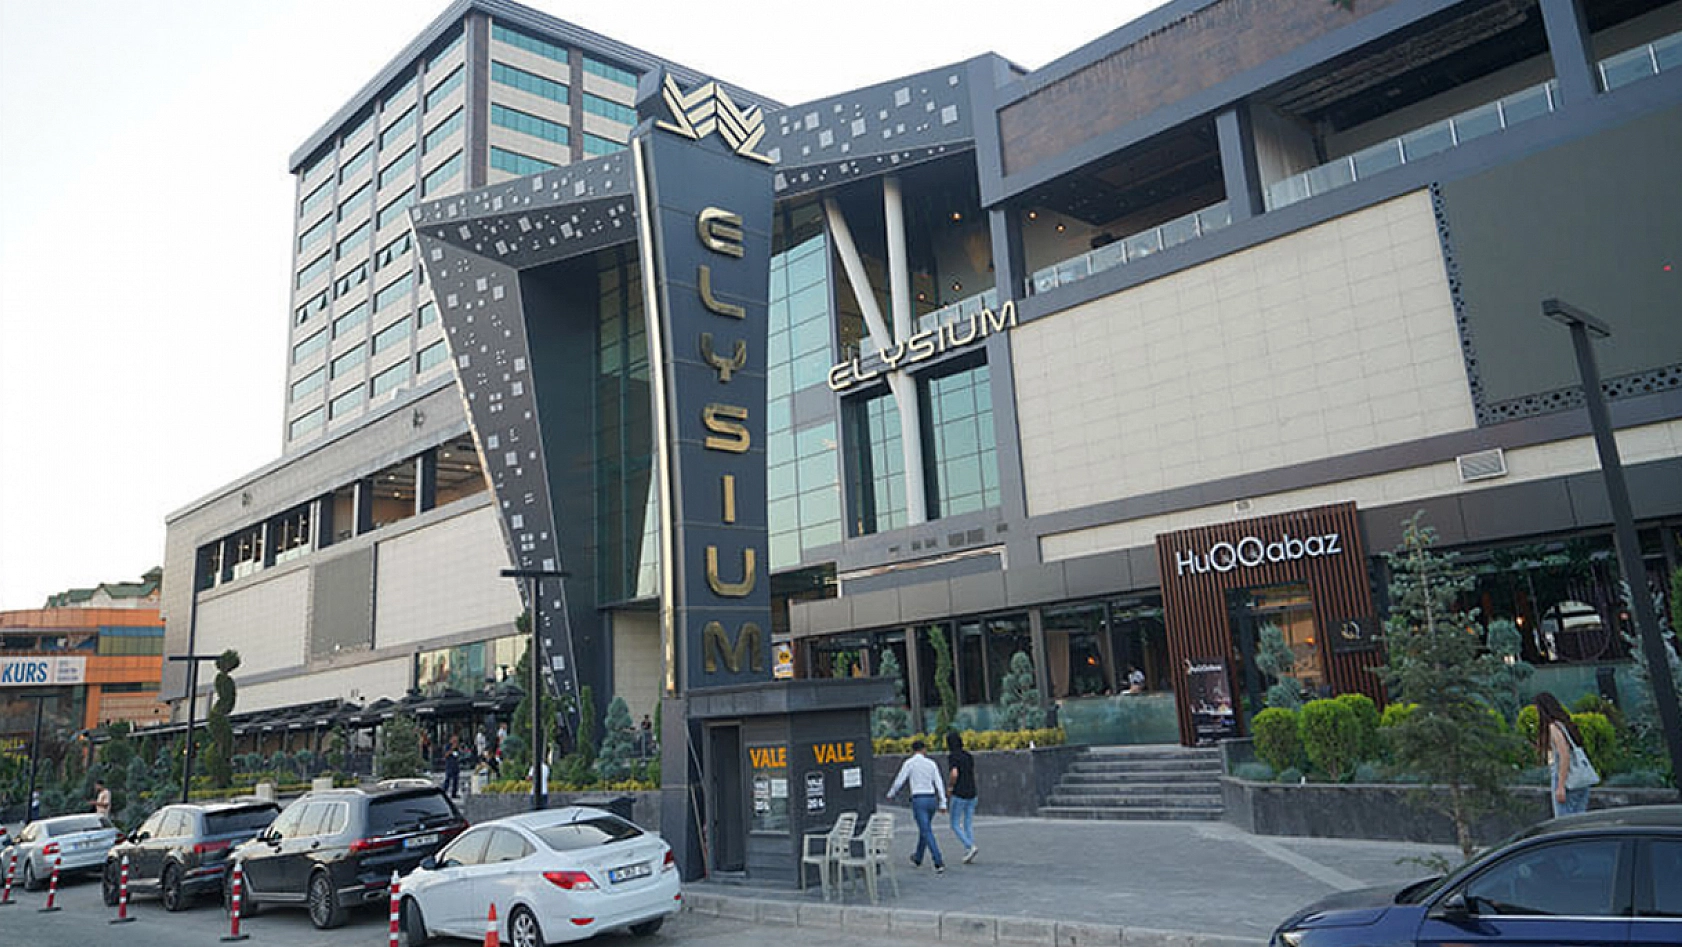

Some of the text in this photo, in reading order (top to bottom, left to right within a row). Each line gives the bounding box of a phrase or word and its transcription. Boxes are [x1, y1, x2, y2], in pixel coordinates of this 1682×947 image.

[828, 300, 1017, 391] ELYSIUM
[697, 206, 763, 673] ELYSIUM
[1176, 533, 1342, 576] HuQQabaz
[2, 662, 48, 682] KURS
[749, 747, 787, 768] VALE
[812, 742, 855, 764] VALE
